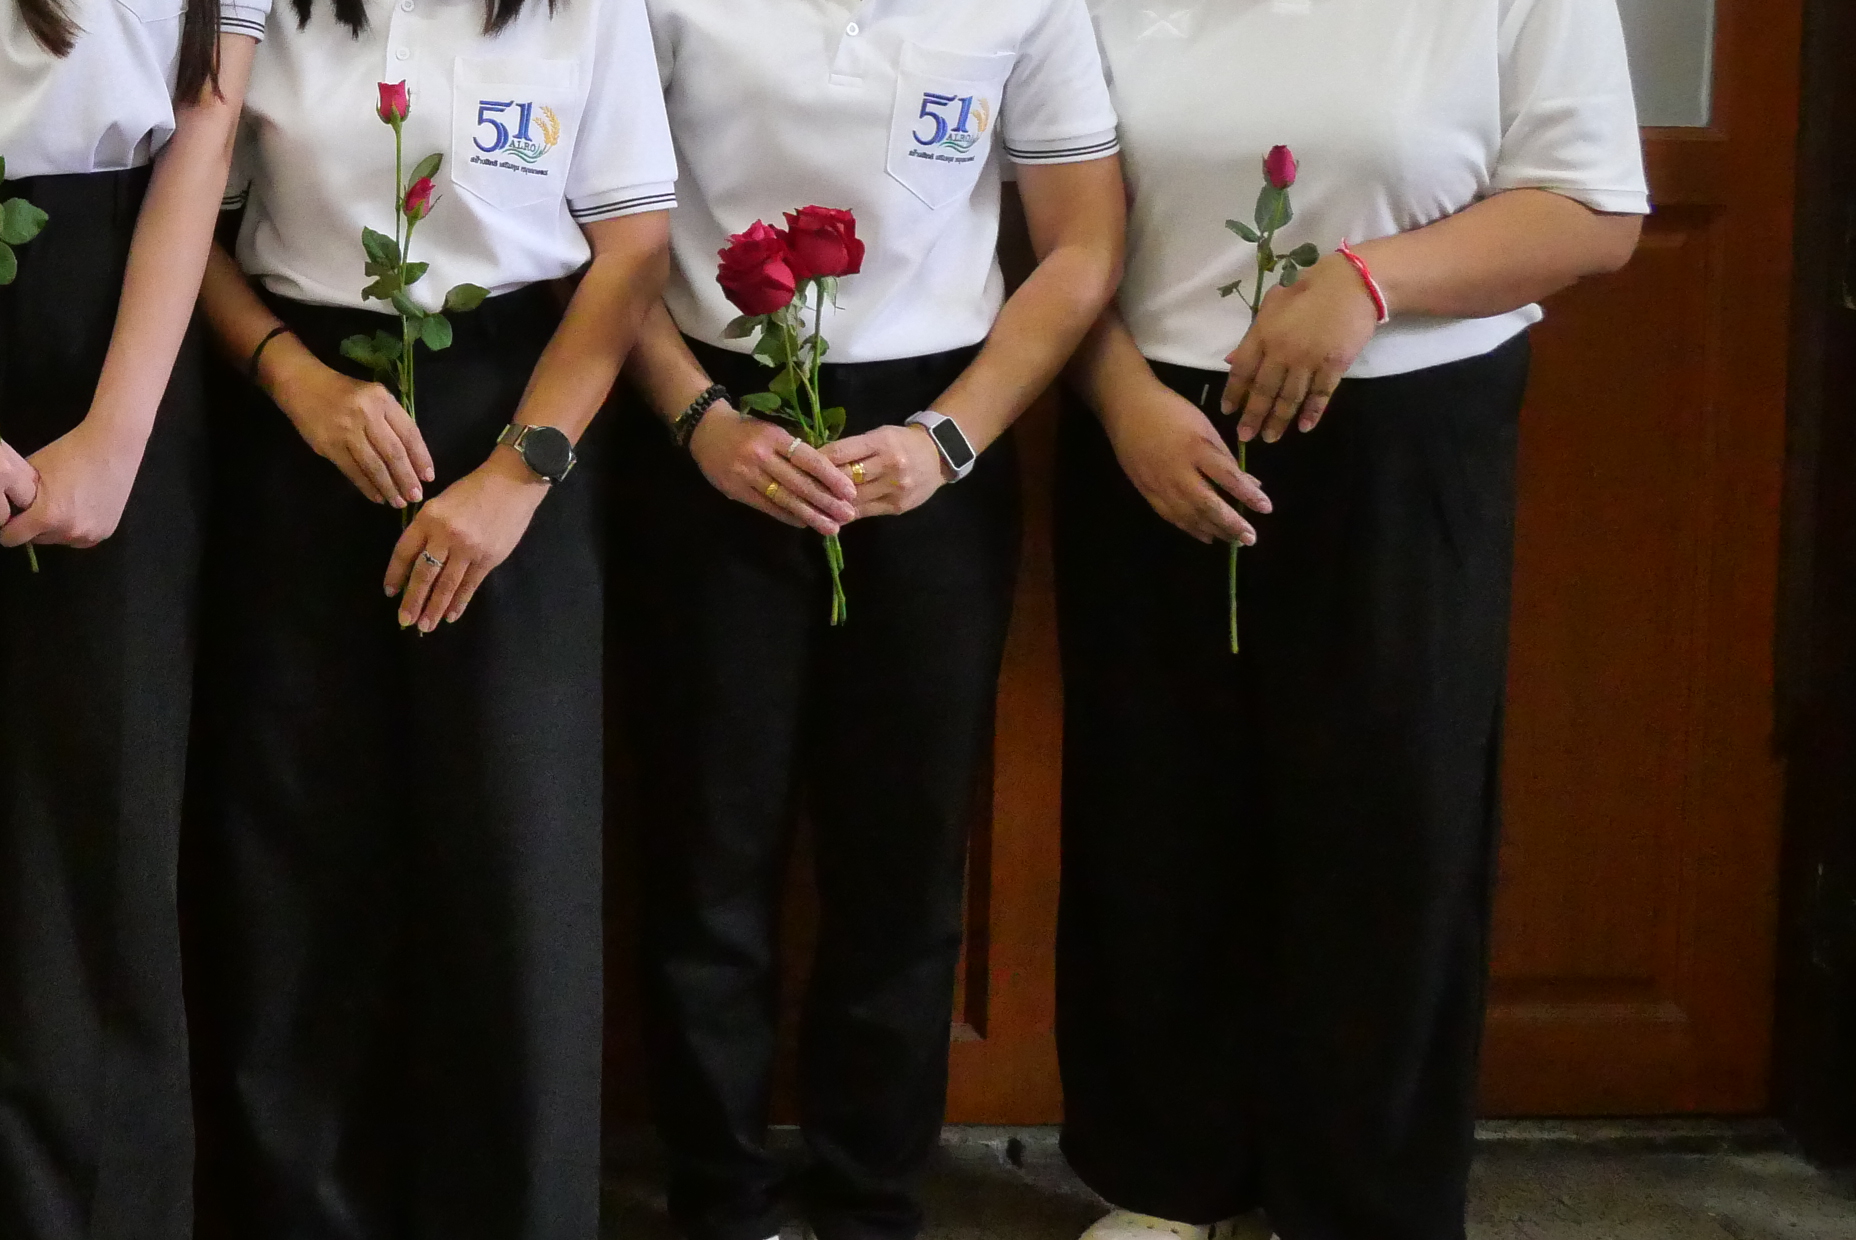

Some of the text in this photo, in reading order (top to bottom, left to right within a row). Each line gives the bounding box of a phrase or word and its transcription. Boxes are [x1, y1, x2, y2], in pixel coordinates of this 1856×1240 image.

[472, 100, 533, 153] 51
[912, 92, 973, 146] 51
[508, 140, 537, 153] ALRO
